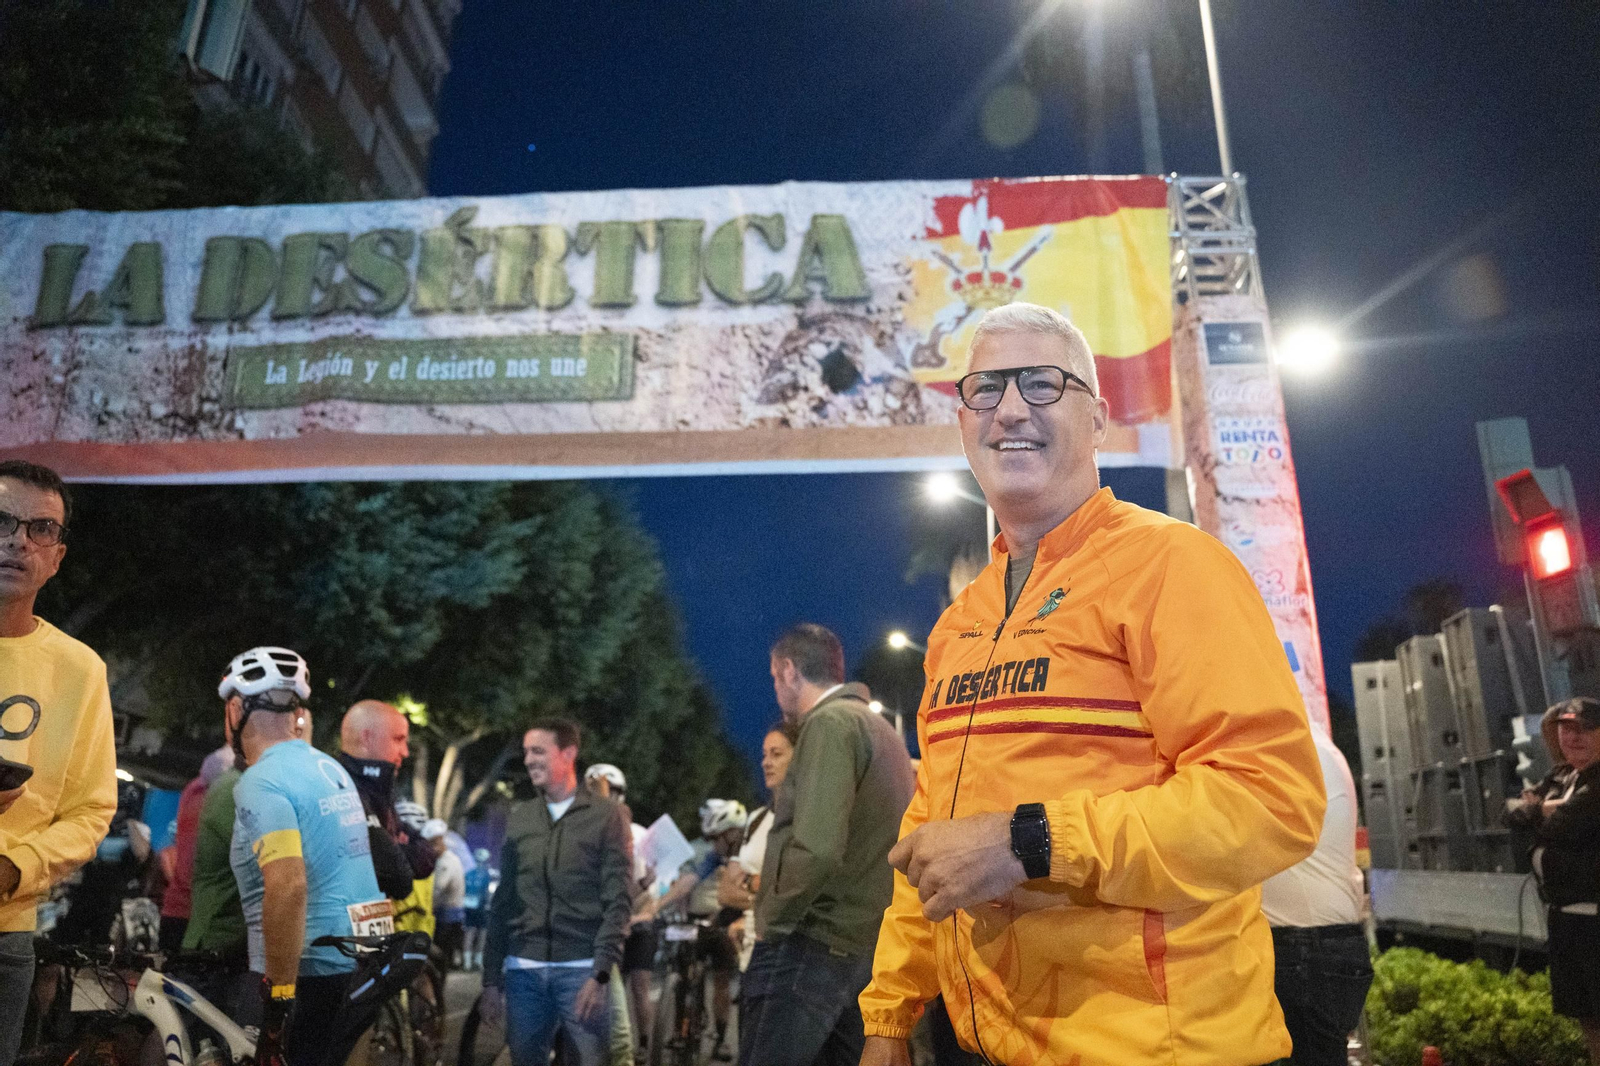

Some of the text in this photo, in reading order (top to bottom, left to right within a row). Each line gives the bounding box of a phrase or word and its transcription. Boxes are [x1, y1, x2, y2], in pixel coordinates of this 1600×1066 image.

[27, 205, 873, 330] LA DESÉRTICA
[265, 351, 588, 385] La Legión y el desierto nos une
[1220, 430, 1279, 443] RENTA
